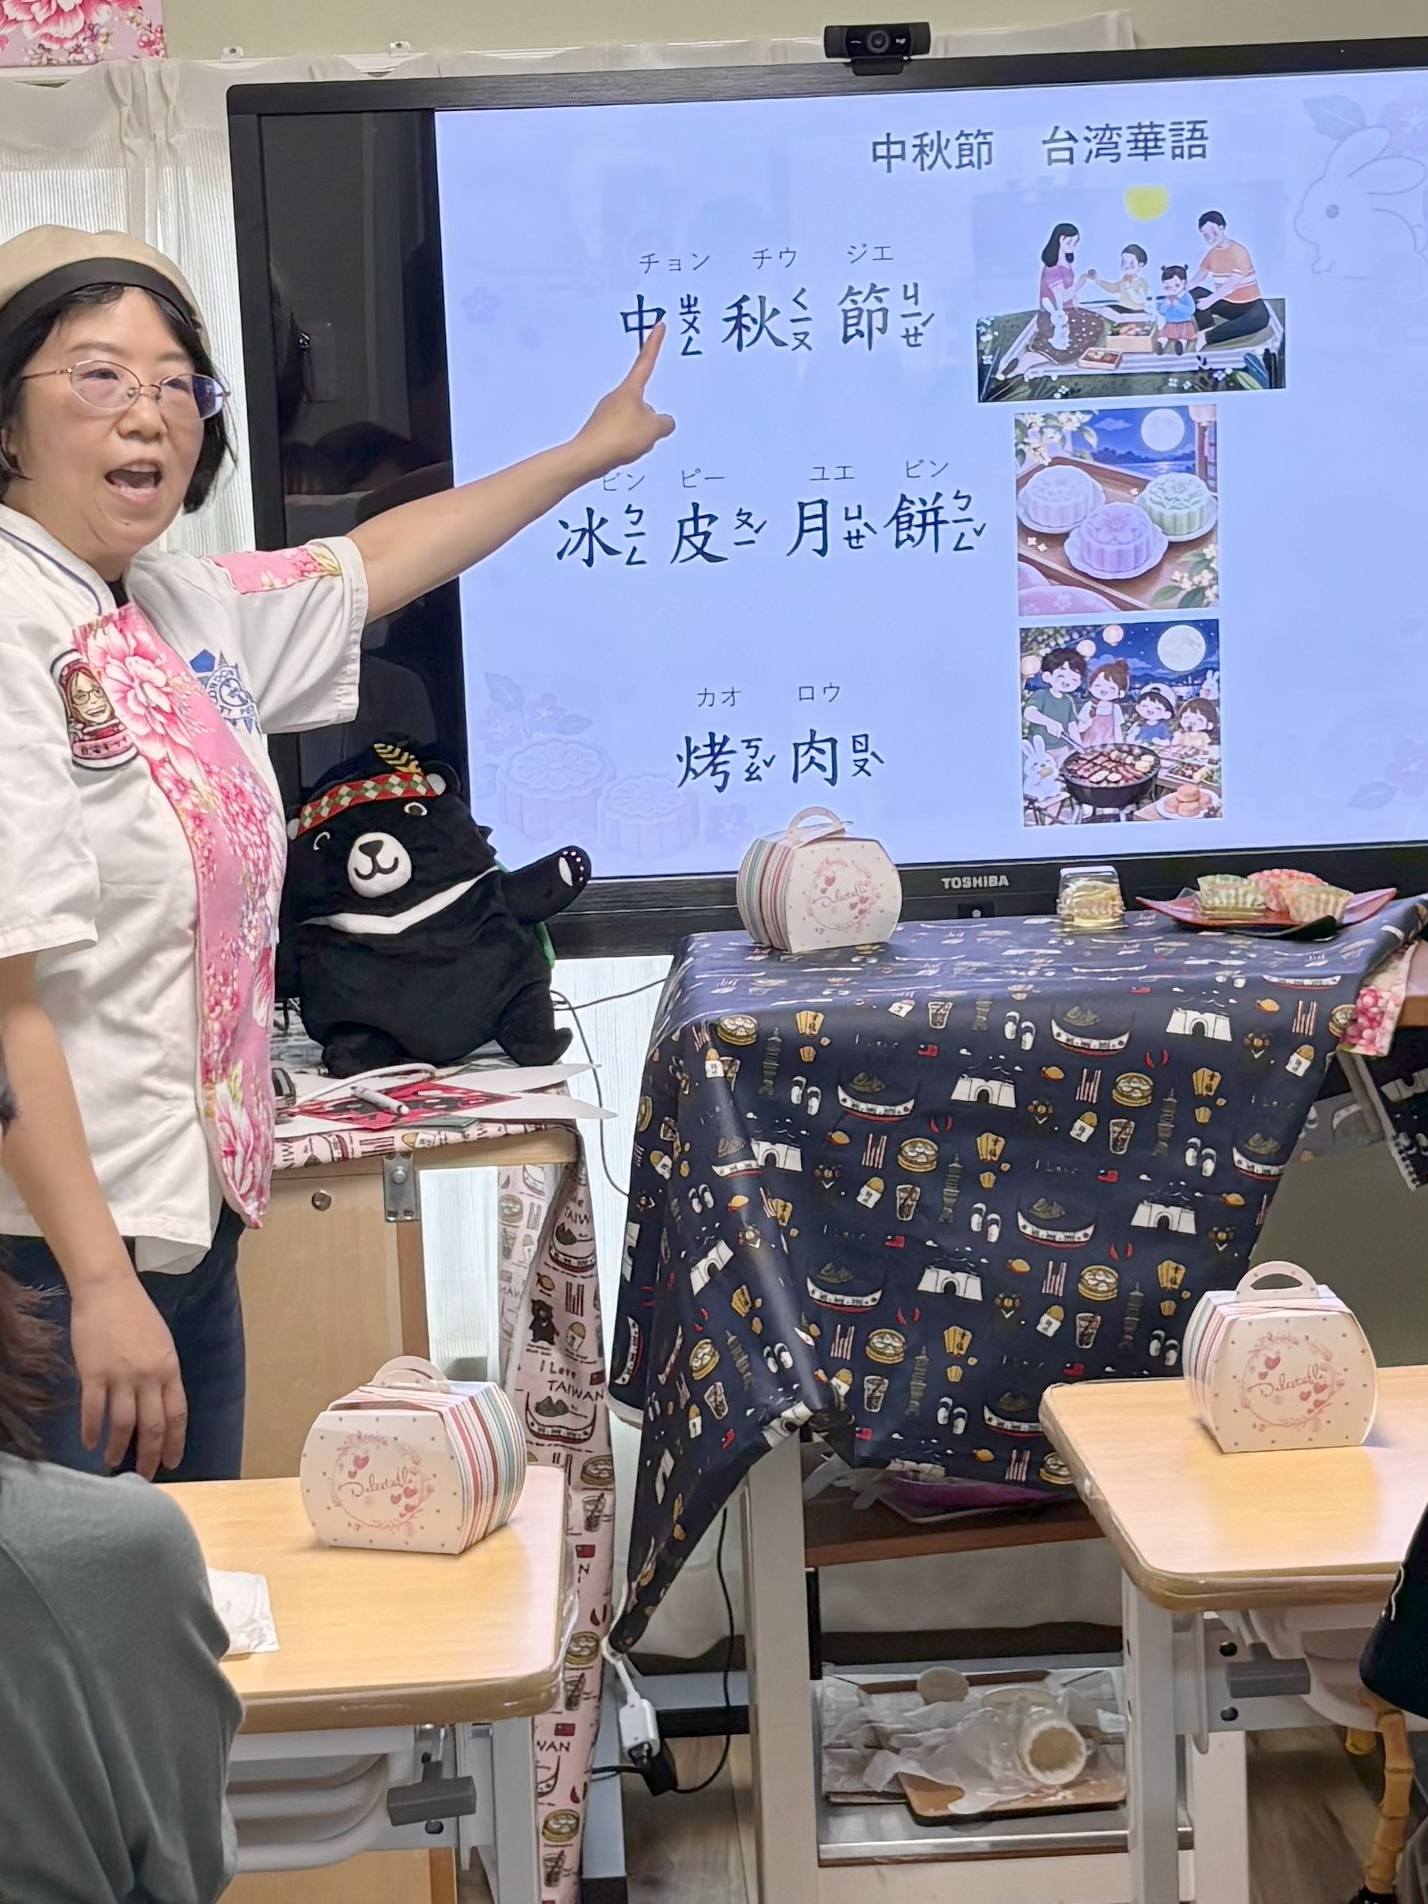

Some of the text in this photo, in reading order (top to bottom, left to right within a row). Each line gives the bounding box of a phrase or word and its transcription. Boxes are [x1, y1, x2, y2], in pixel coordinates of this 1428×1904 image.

[871, 118, 1210, 174] 中秋節 台湾華語
[638, 242, 895, 274] チョン チウ ジエ
[681, 468, 726, 489] ピー
[808, 465, 856, 483] ユエ
[905, 459, 950, 480] ビン
[697, 682, 841, 708] カオ ロウ
[941, 874, 1011, 890] TOSHIBA
[547, 1378, 605, 1403] TAIWAN
